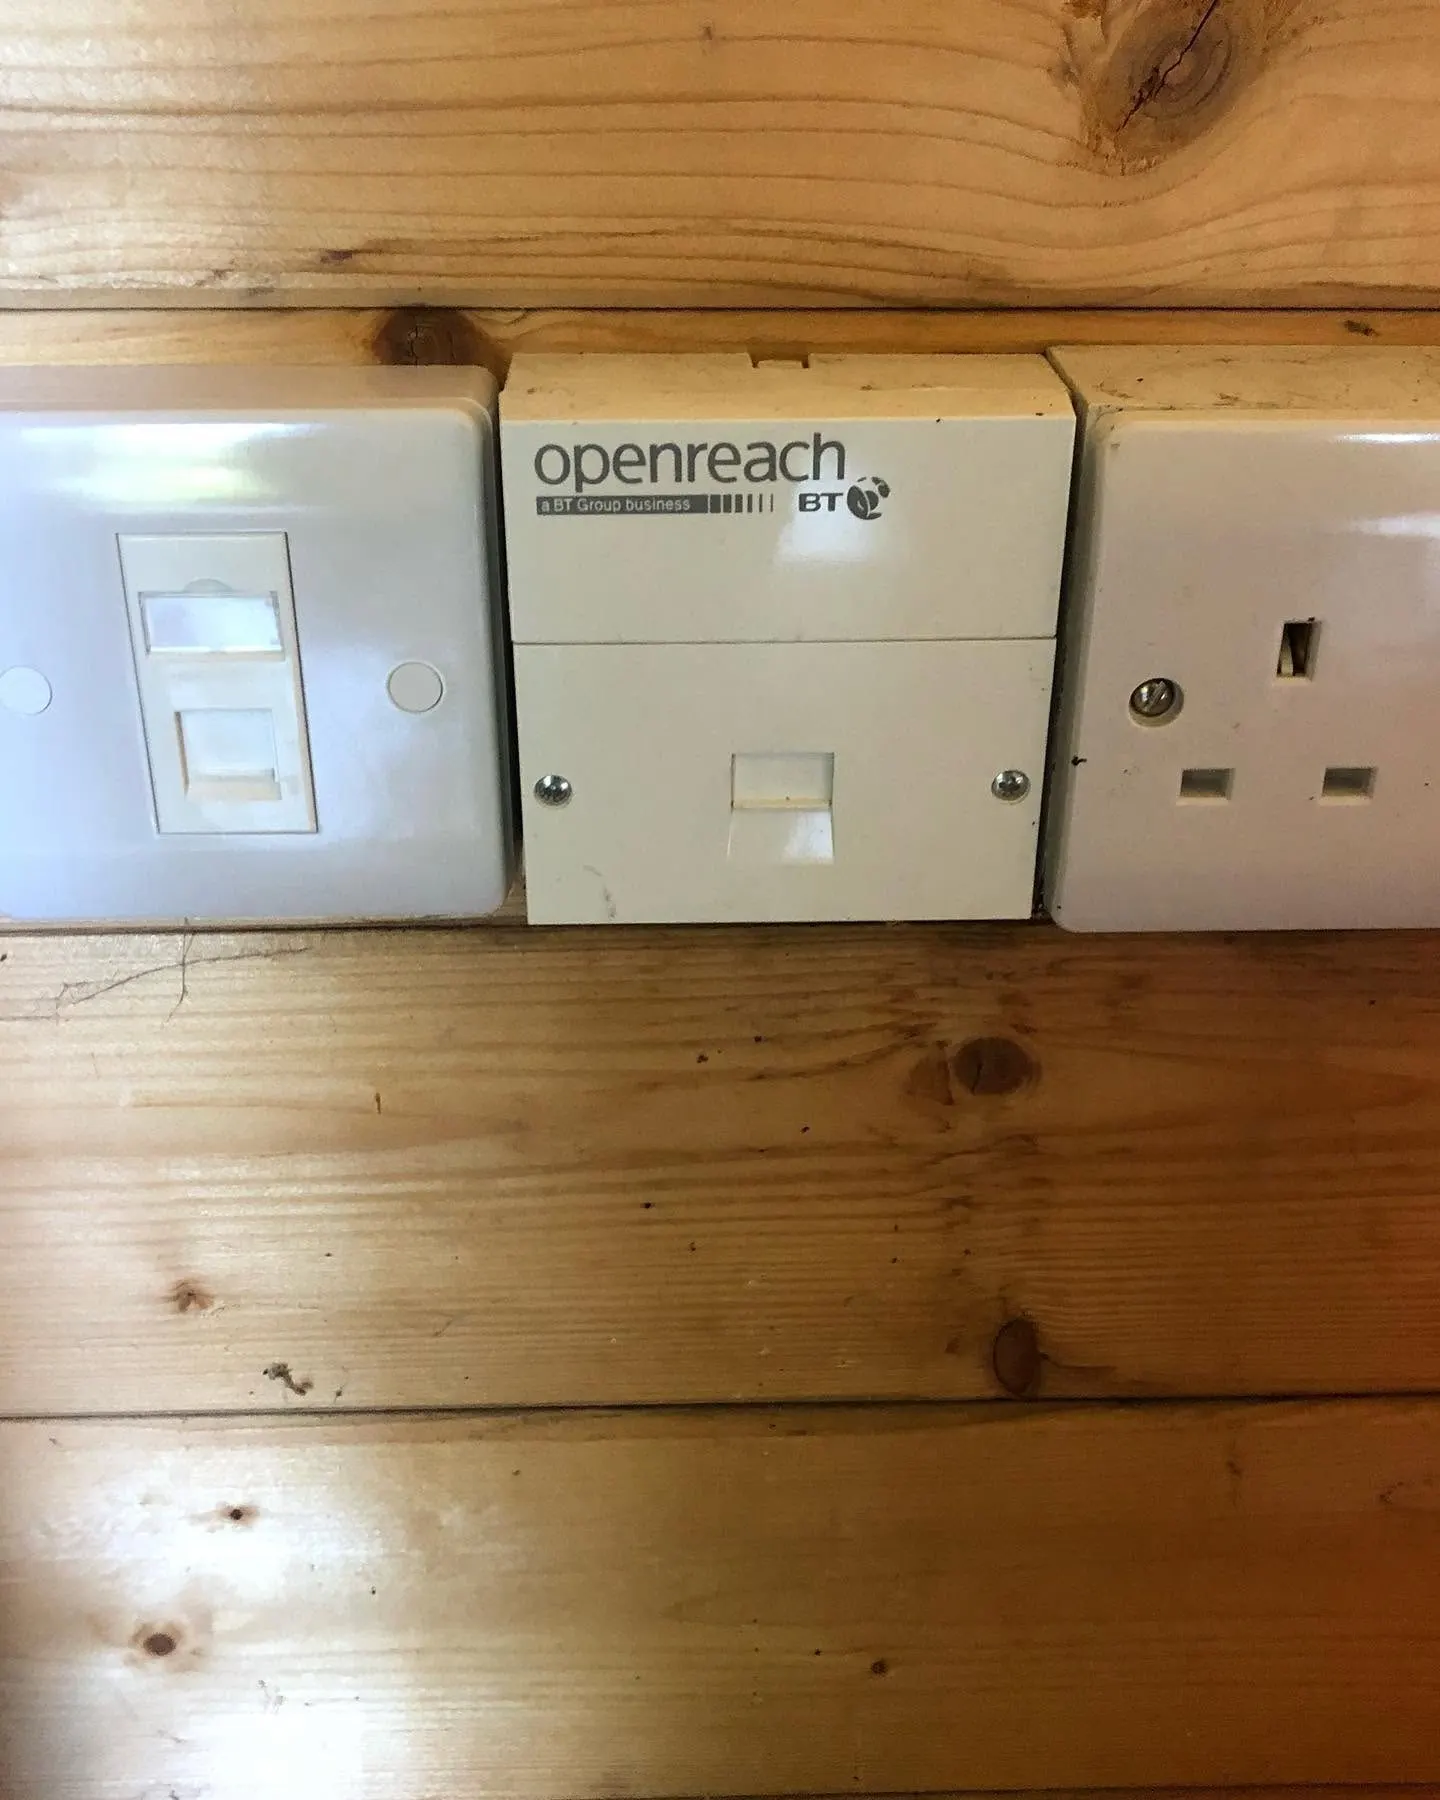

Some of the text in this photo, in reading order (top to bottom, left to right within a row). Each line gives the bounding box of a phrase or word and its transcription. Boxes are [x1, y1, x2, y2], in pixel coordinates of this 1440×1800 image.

[534, 432, 846, 493] openreach
[540, 498, 691, 514] a BT Group business
[799, 493, 844, 512] BT
